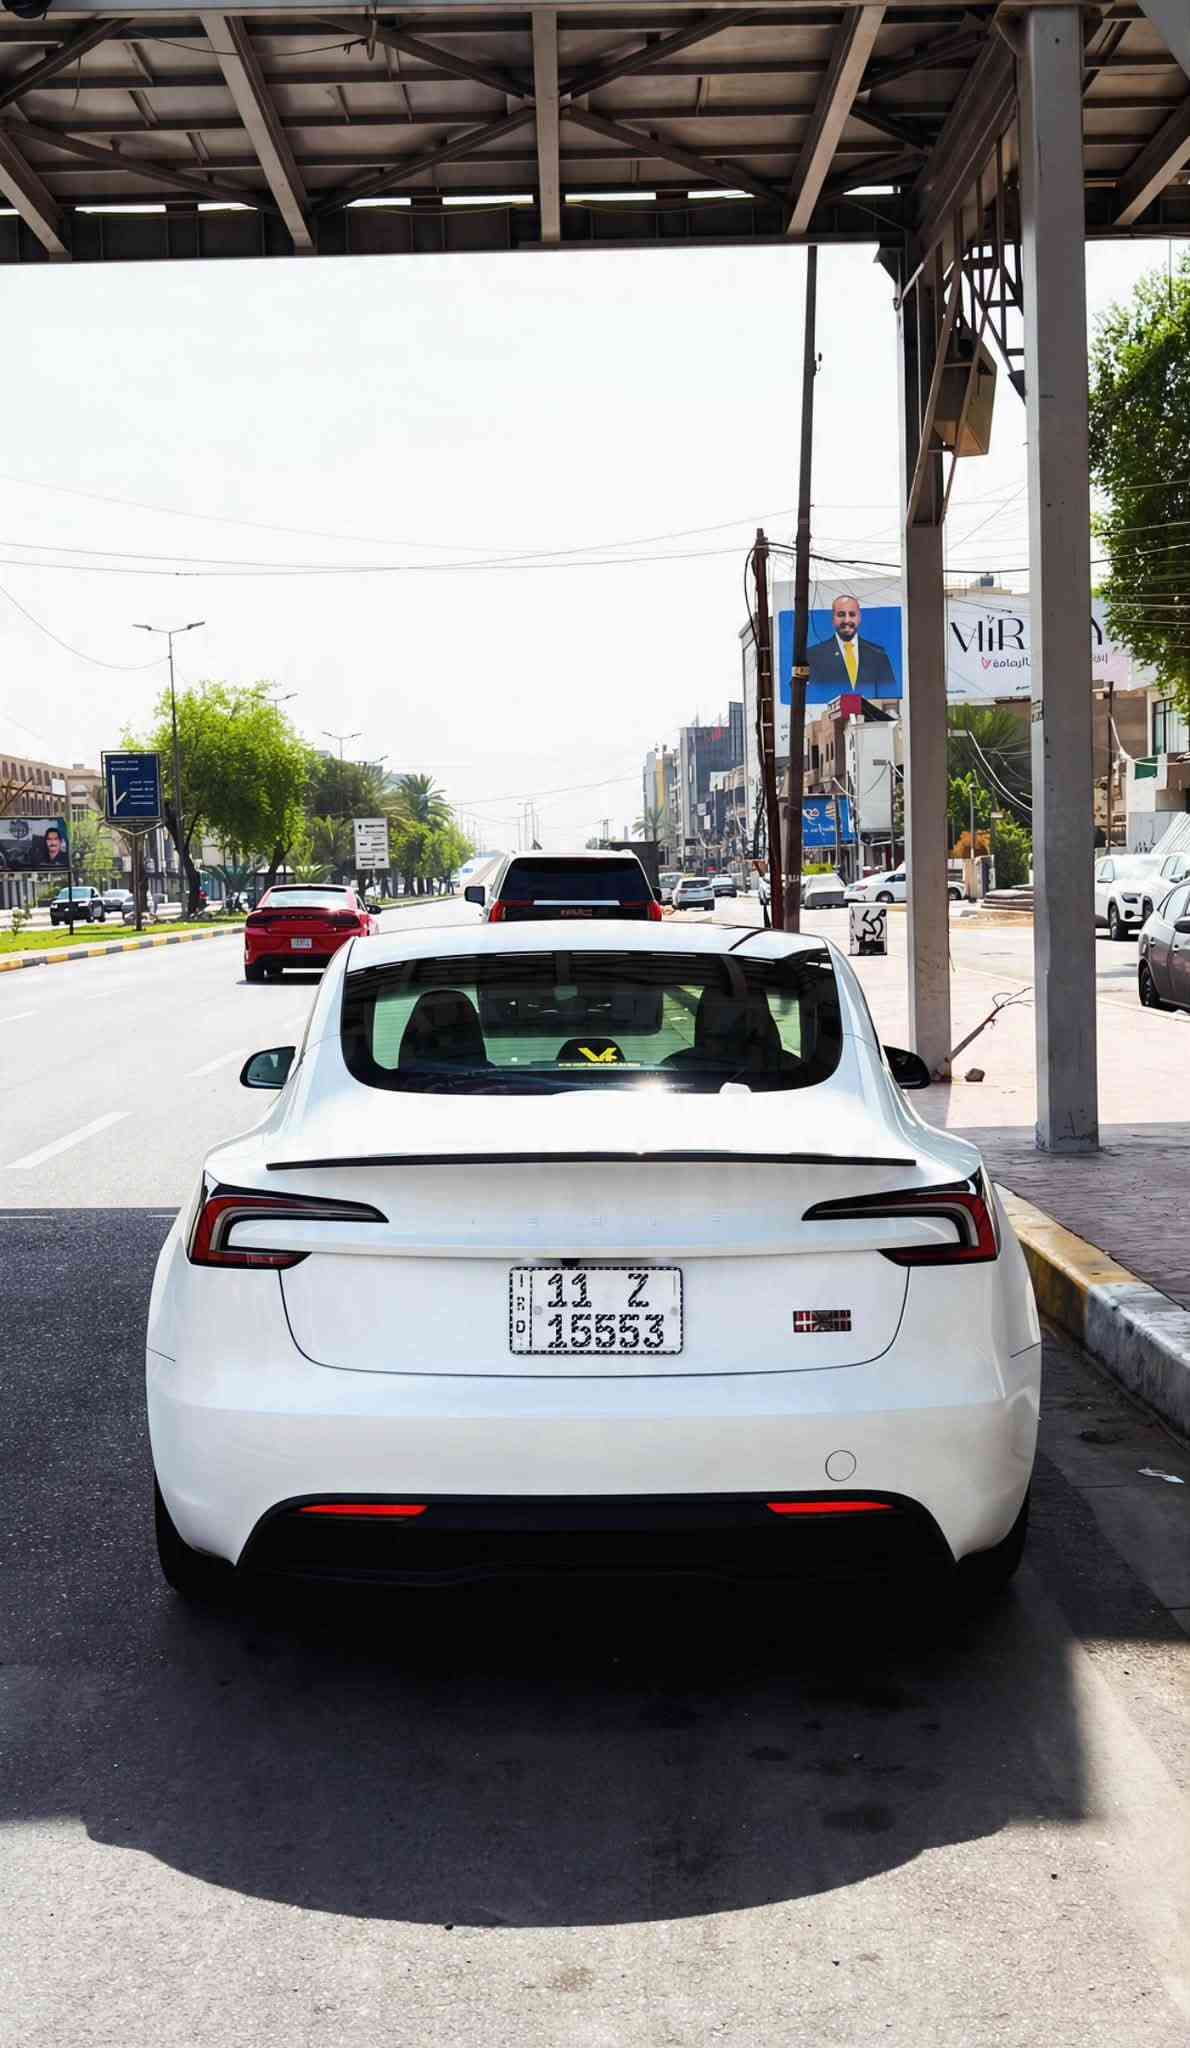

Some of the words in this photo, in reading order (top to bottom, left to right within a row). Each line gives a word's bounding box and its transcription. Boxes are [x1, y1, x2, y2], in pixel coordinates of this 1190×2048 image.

[547, 1272, 592, 1308] 11
[627, 1272, 649, 1308] Z
[548, 1313, 664, 1349] 15553
